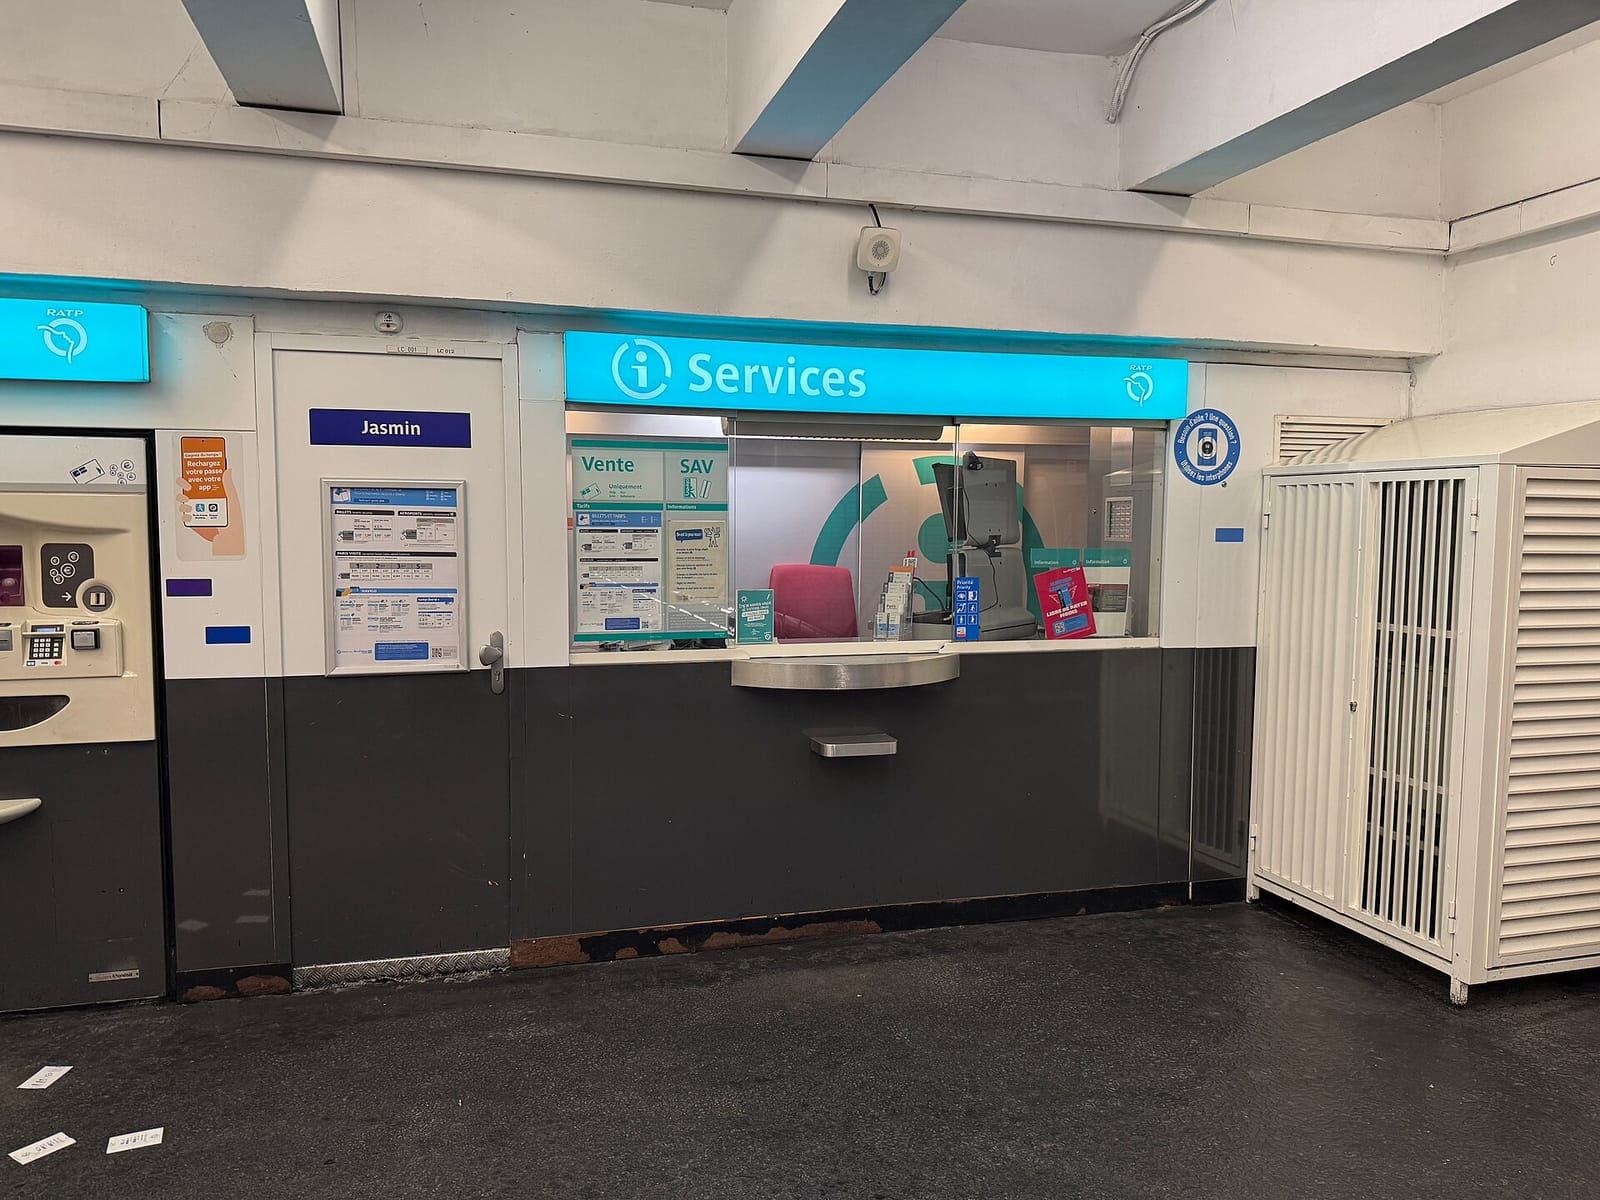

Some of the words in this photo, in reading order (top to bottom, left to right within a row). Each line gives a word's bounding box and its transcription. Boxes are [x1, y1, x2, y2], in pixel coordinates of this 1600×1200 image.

[47, 308, 84, 317] RATP
[688, 353, 867, 398] Services
[361, 420, 421, 436] Jasmin
[1178, 425, 1191, 444] Besoin
[1189, 414, 1205, 427] d'aide
[1209, 412, 1219, 423] Une
[1218, 418, 1235, 440] question
[187, 460, 221, 469] Rechargez
[581, 456, 635, 473] Vente
[680, 458, 714, 474] SAV
[1180, 459, 1197, 478] Utilisez
[1195, 473, 1205, 481] les
[204, 469, 223, 477] passe
